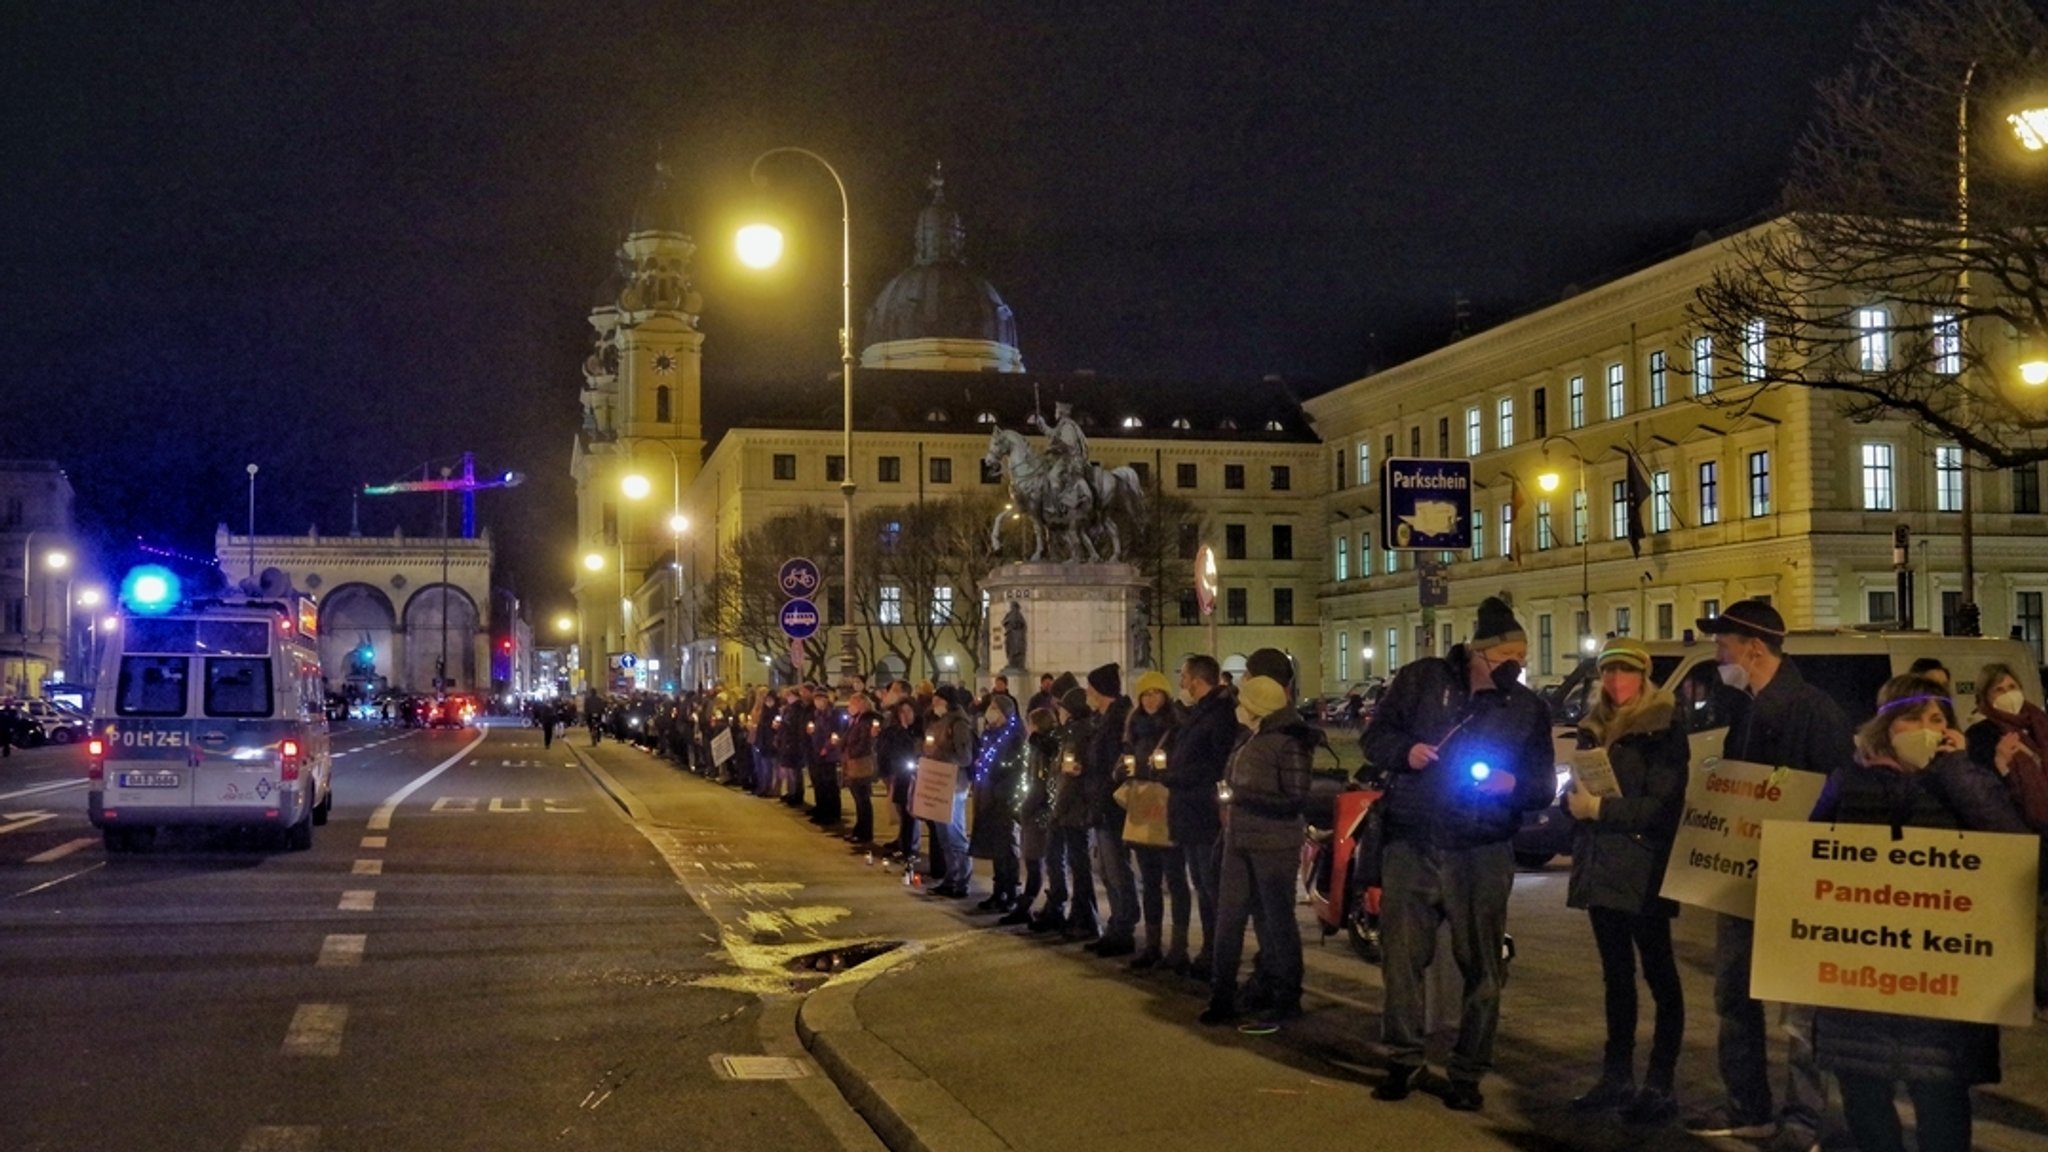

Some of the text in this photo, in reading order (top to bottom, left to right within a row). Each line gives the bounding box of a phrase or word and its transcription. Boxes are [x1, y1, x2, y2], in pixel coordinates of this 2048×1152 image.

[1393, 470, 1466, 489] Parkschein
[109, 731, 190, 746] POLIZEI
[1706, 774, 1781, 801] Gesunde
[1684, 809, 1730, 837] Kinder,
[1689, 848, 1758, 878] testen?
[1812, 839, 1981, 870] Eine echte
[1815, 879, 1973, 911] Pandemie
[1790, 919, 1994, 957] braucht kein
[1818, 962, 1959, 995] Bußgeld!
